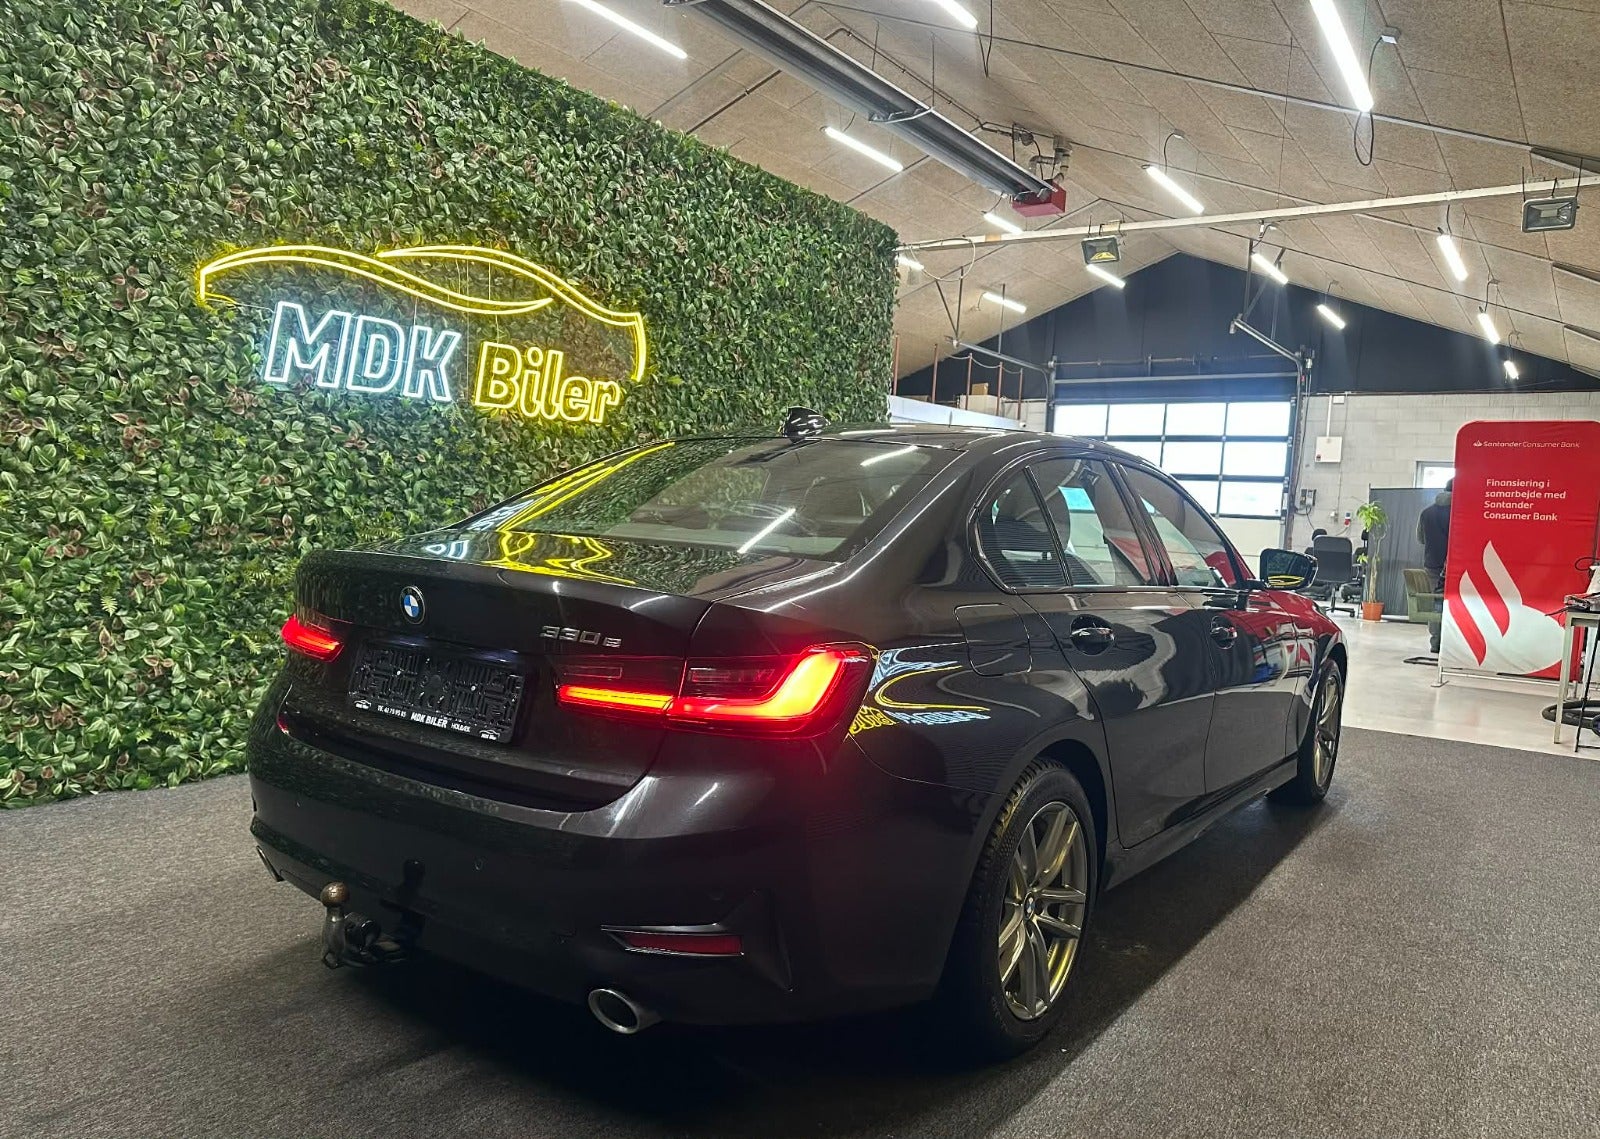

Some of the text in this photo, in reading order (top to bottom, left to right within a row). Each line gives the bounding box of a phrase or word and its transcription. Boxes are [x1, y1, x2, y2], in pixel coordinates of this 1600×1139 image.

[264, 300, 622, 424] MDK Biler
[1483, 440, 1522, 448] Santander
[1486, 479, 1545, 490] Finansiering
[1485, 490, 1567, 500] samarbejde med
[1484, 500, 1534, 509] Santander
[1483, 511, 1558, 521] Consumer Bank
[410, 711, 427, 723] MDK
[425, 715, 448, 729] BILER
